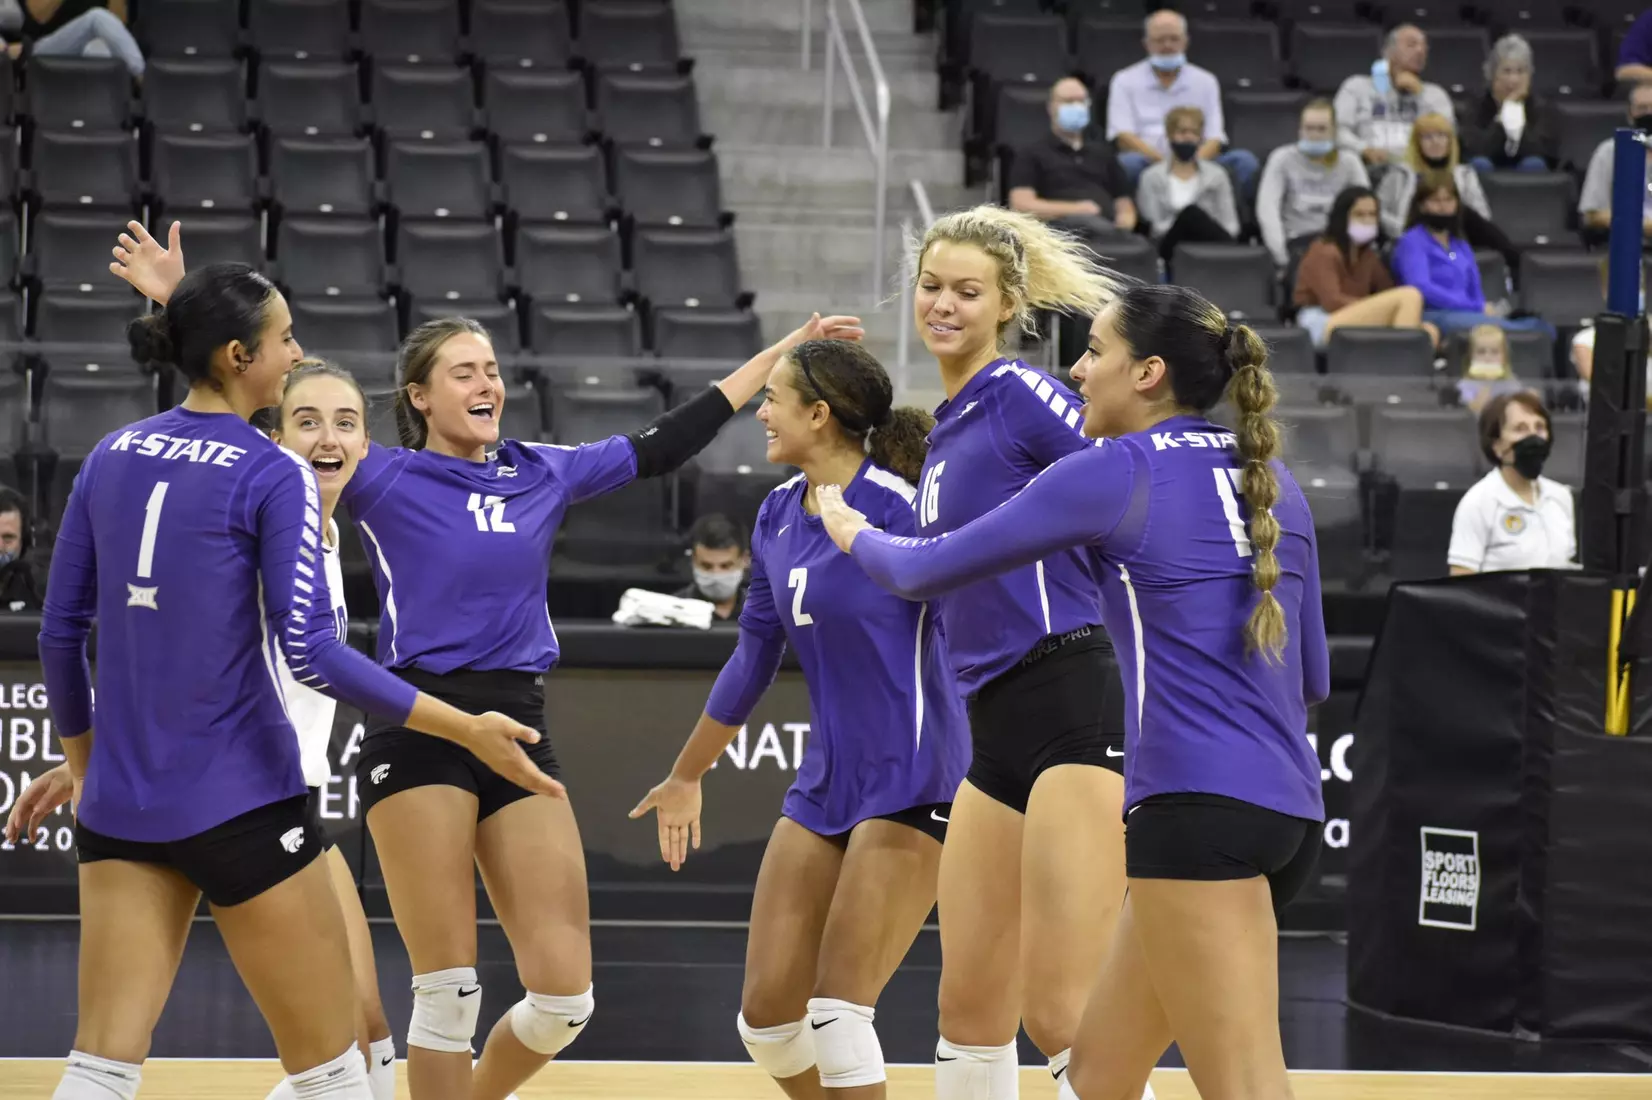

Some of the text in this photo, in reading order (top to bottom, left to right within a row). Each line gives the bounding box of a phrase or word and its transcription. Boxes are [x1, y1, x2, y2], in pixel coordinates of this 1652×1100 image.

[110, 431, 247, 467] K-STATE
[920, 460, 946, 528] 16
[137, 481, 169, 578] 1
[467, 493, 516, 532] 12
[788, 567, 813, 626] 2
[1021, 638, 1058, 667] NIKE
[1425, 850, 1475, 873] SPORT
[1424, 871, 1476, 890] FLOORS
[1424, 886, 1474, 907] LEASING
